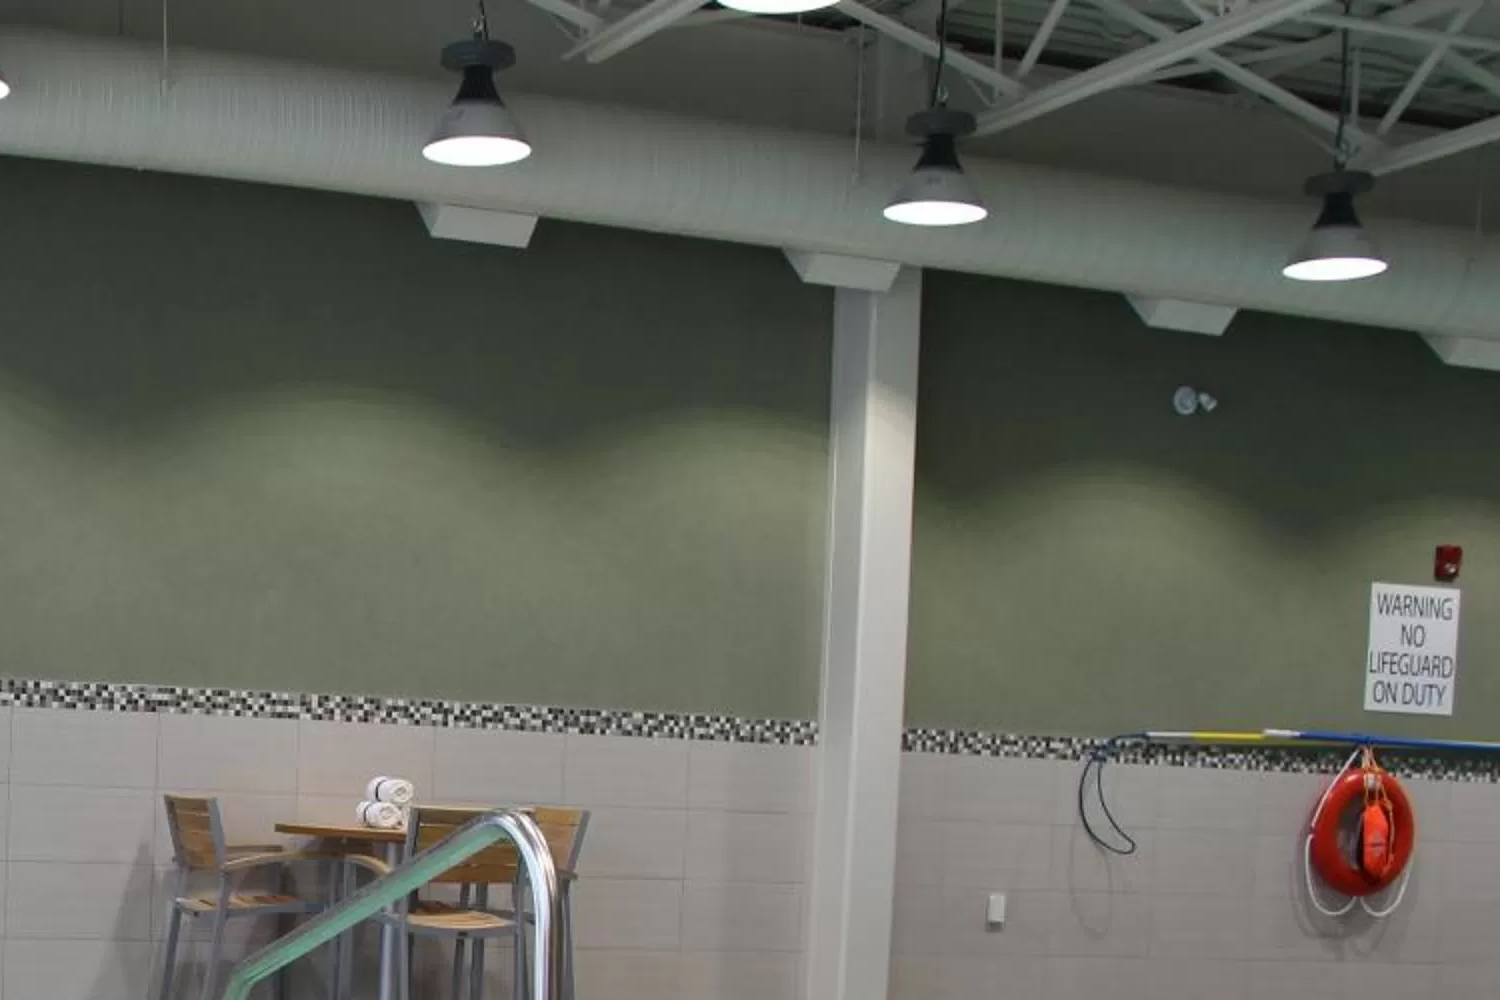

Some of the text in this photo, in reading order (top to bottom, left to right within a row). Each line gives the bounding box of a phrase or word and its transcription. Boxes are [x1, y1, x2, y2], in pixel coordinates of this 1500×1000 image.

[1377, 592, 1453, 620] WARNING
[1401, 624, 1425, 648] NO
[1369, 652, 1453, 678] LIFEGUARD
[1373, 680, 1446, 706] ON DUTY
